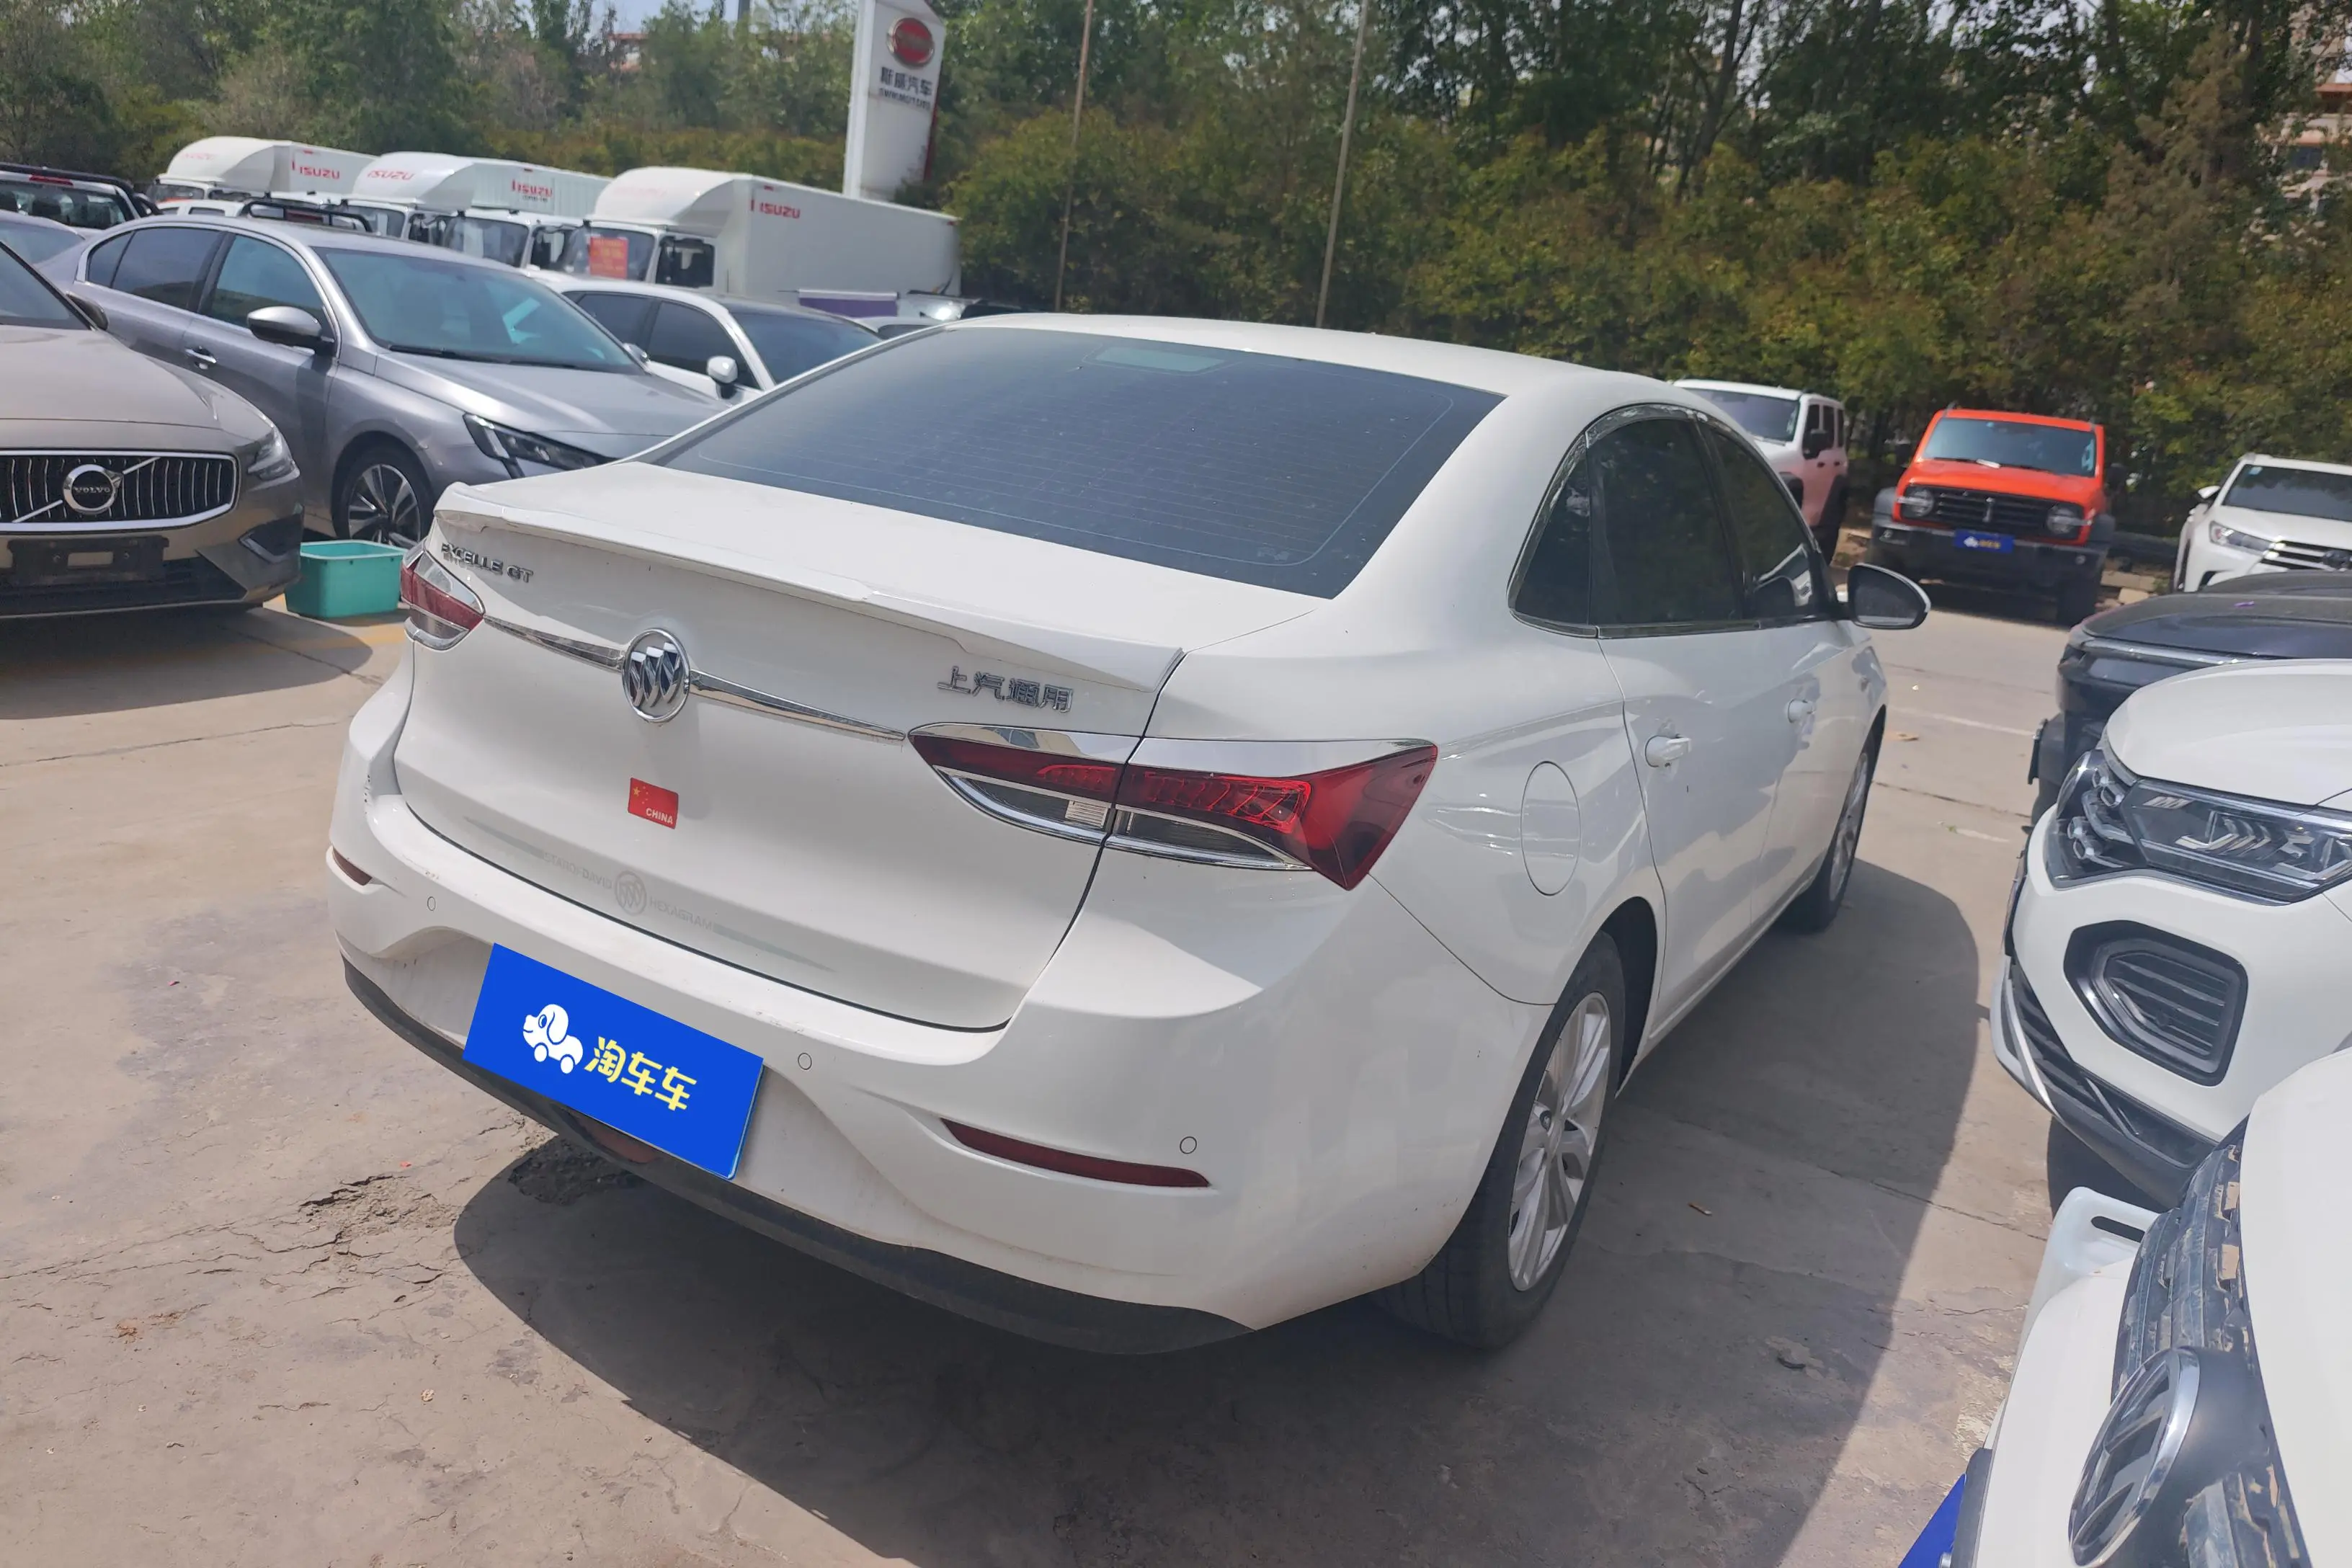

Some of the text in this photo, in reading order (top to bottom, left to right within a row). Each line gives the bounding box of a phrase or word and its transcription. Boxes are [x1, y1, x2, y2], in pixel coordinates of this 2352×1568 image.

[299, 166, 340, 179] ISUZU
[367, 169, 416, 181] ISUZU
[516, 182, 553, 198] ISUZU
[759, 202, 802, 219] ISUZU
[441, 542, 534, 583] EXCELLE GT
[937, 665, 1074, 713] 上汽通用
[646, 807, 674, 825] CHINA
